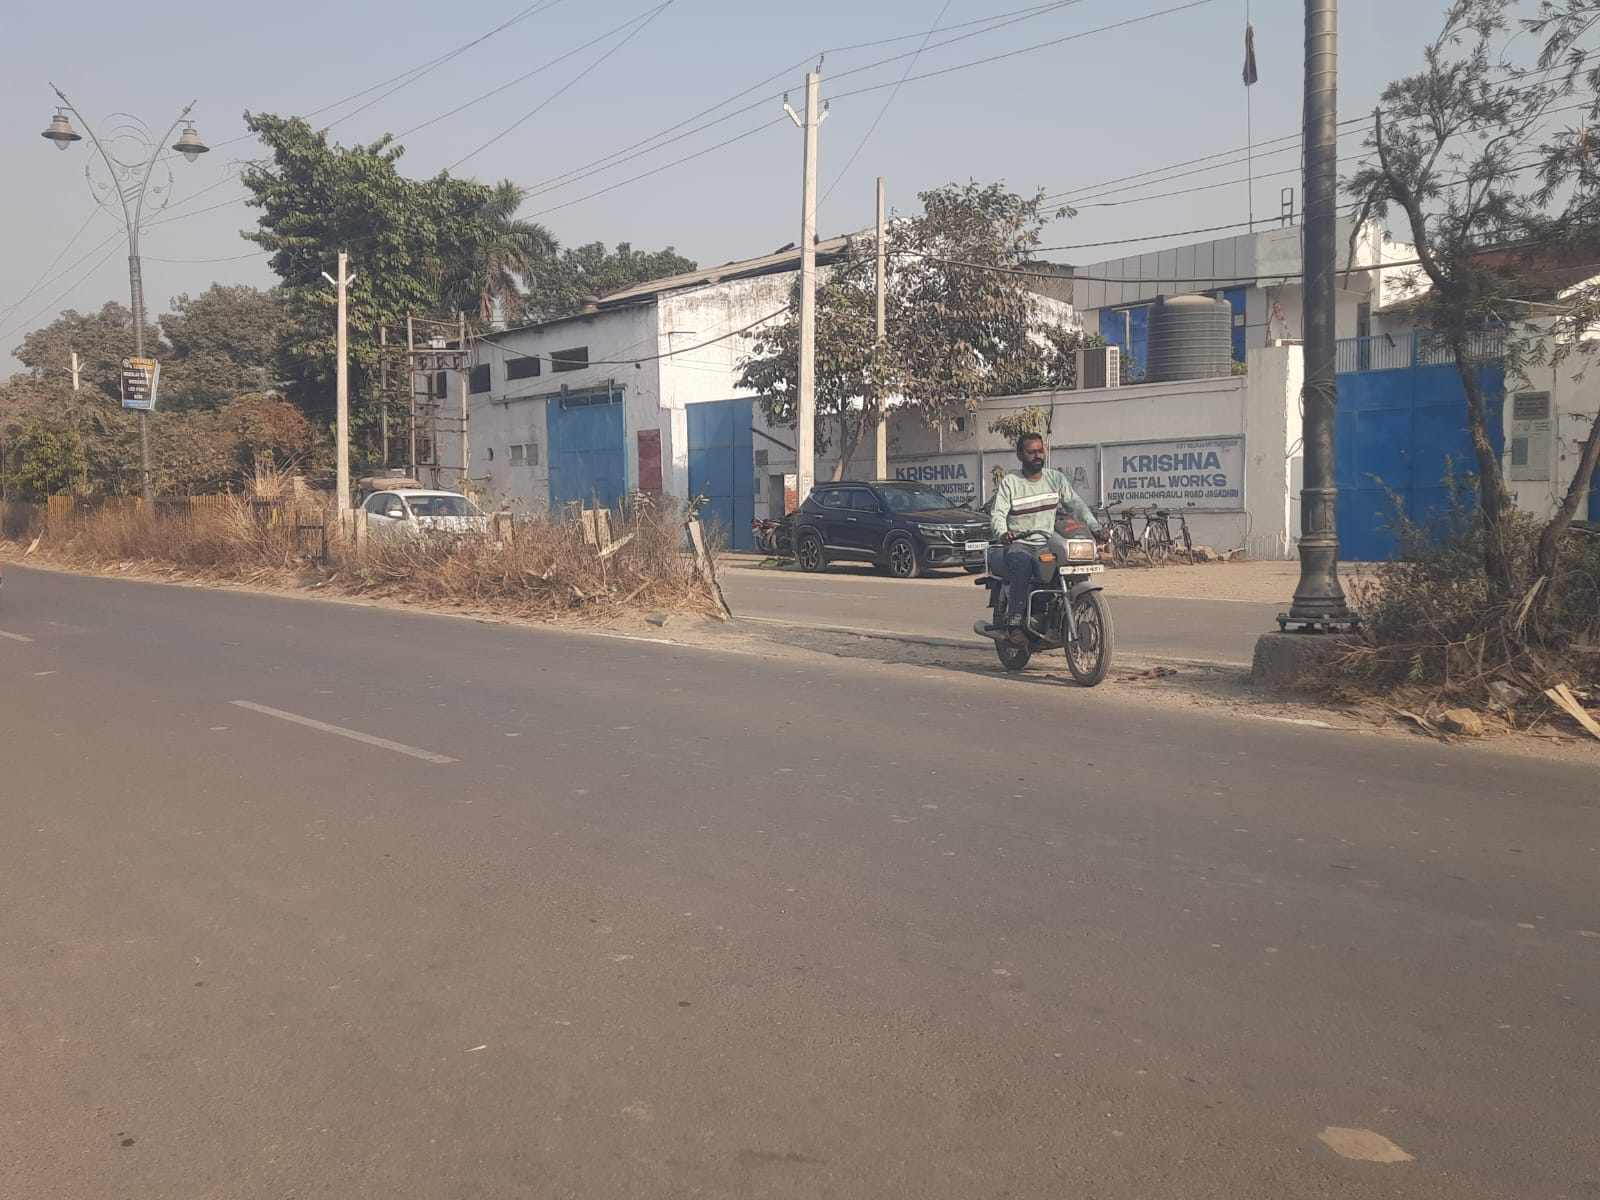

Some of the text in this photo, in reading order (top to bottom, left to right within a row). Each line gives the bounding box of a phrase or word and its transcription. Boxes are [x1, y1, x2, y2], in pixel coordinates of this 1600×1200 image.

[1122, 451, 1221, 472] KRISHNA
[895, 464, 967, 480] KRISHNA
[1113, 474, 1227, 489] METAL WORKS
[1107, 490, 1125, 500] NEW
[1184, 488, 1204, 499] ROAD
